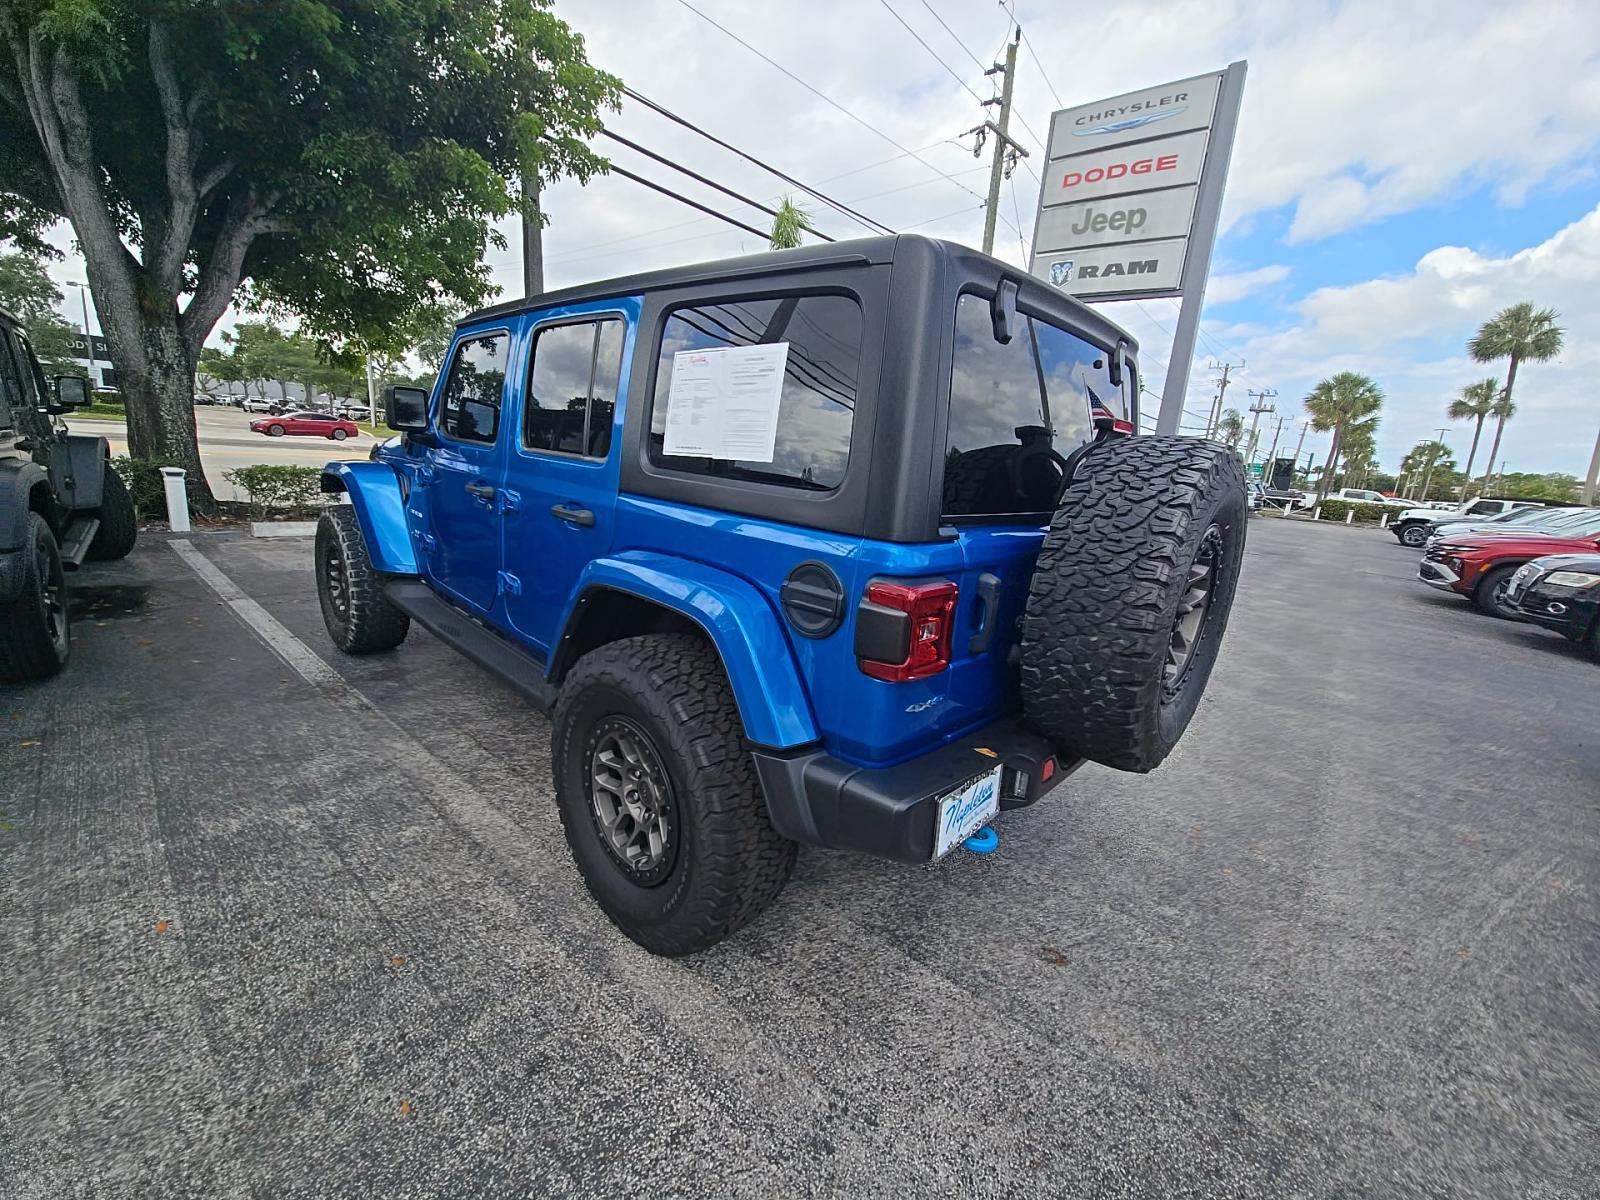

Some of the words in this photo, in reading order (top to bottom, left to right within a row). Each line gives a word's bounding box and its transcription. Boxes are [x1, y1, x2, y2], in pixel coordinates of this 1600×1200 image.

[1075, 92, 1188, 126] CHRYSLER
[1062, 154, 1179, 189] DODGE
[1071, 207, 1147, 235] Jeep
[1078, 259, 1159, 279] RAM
